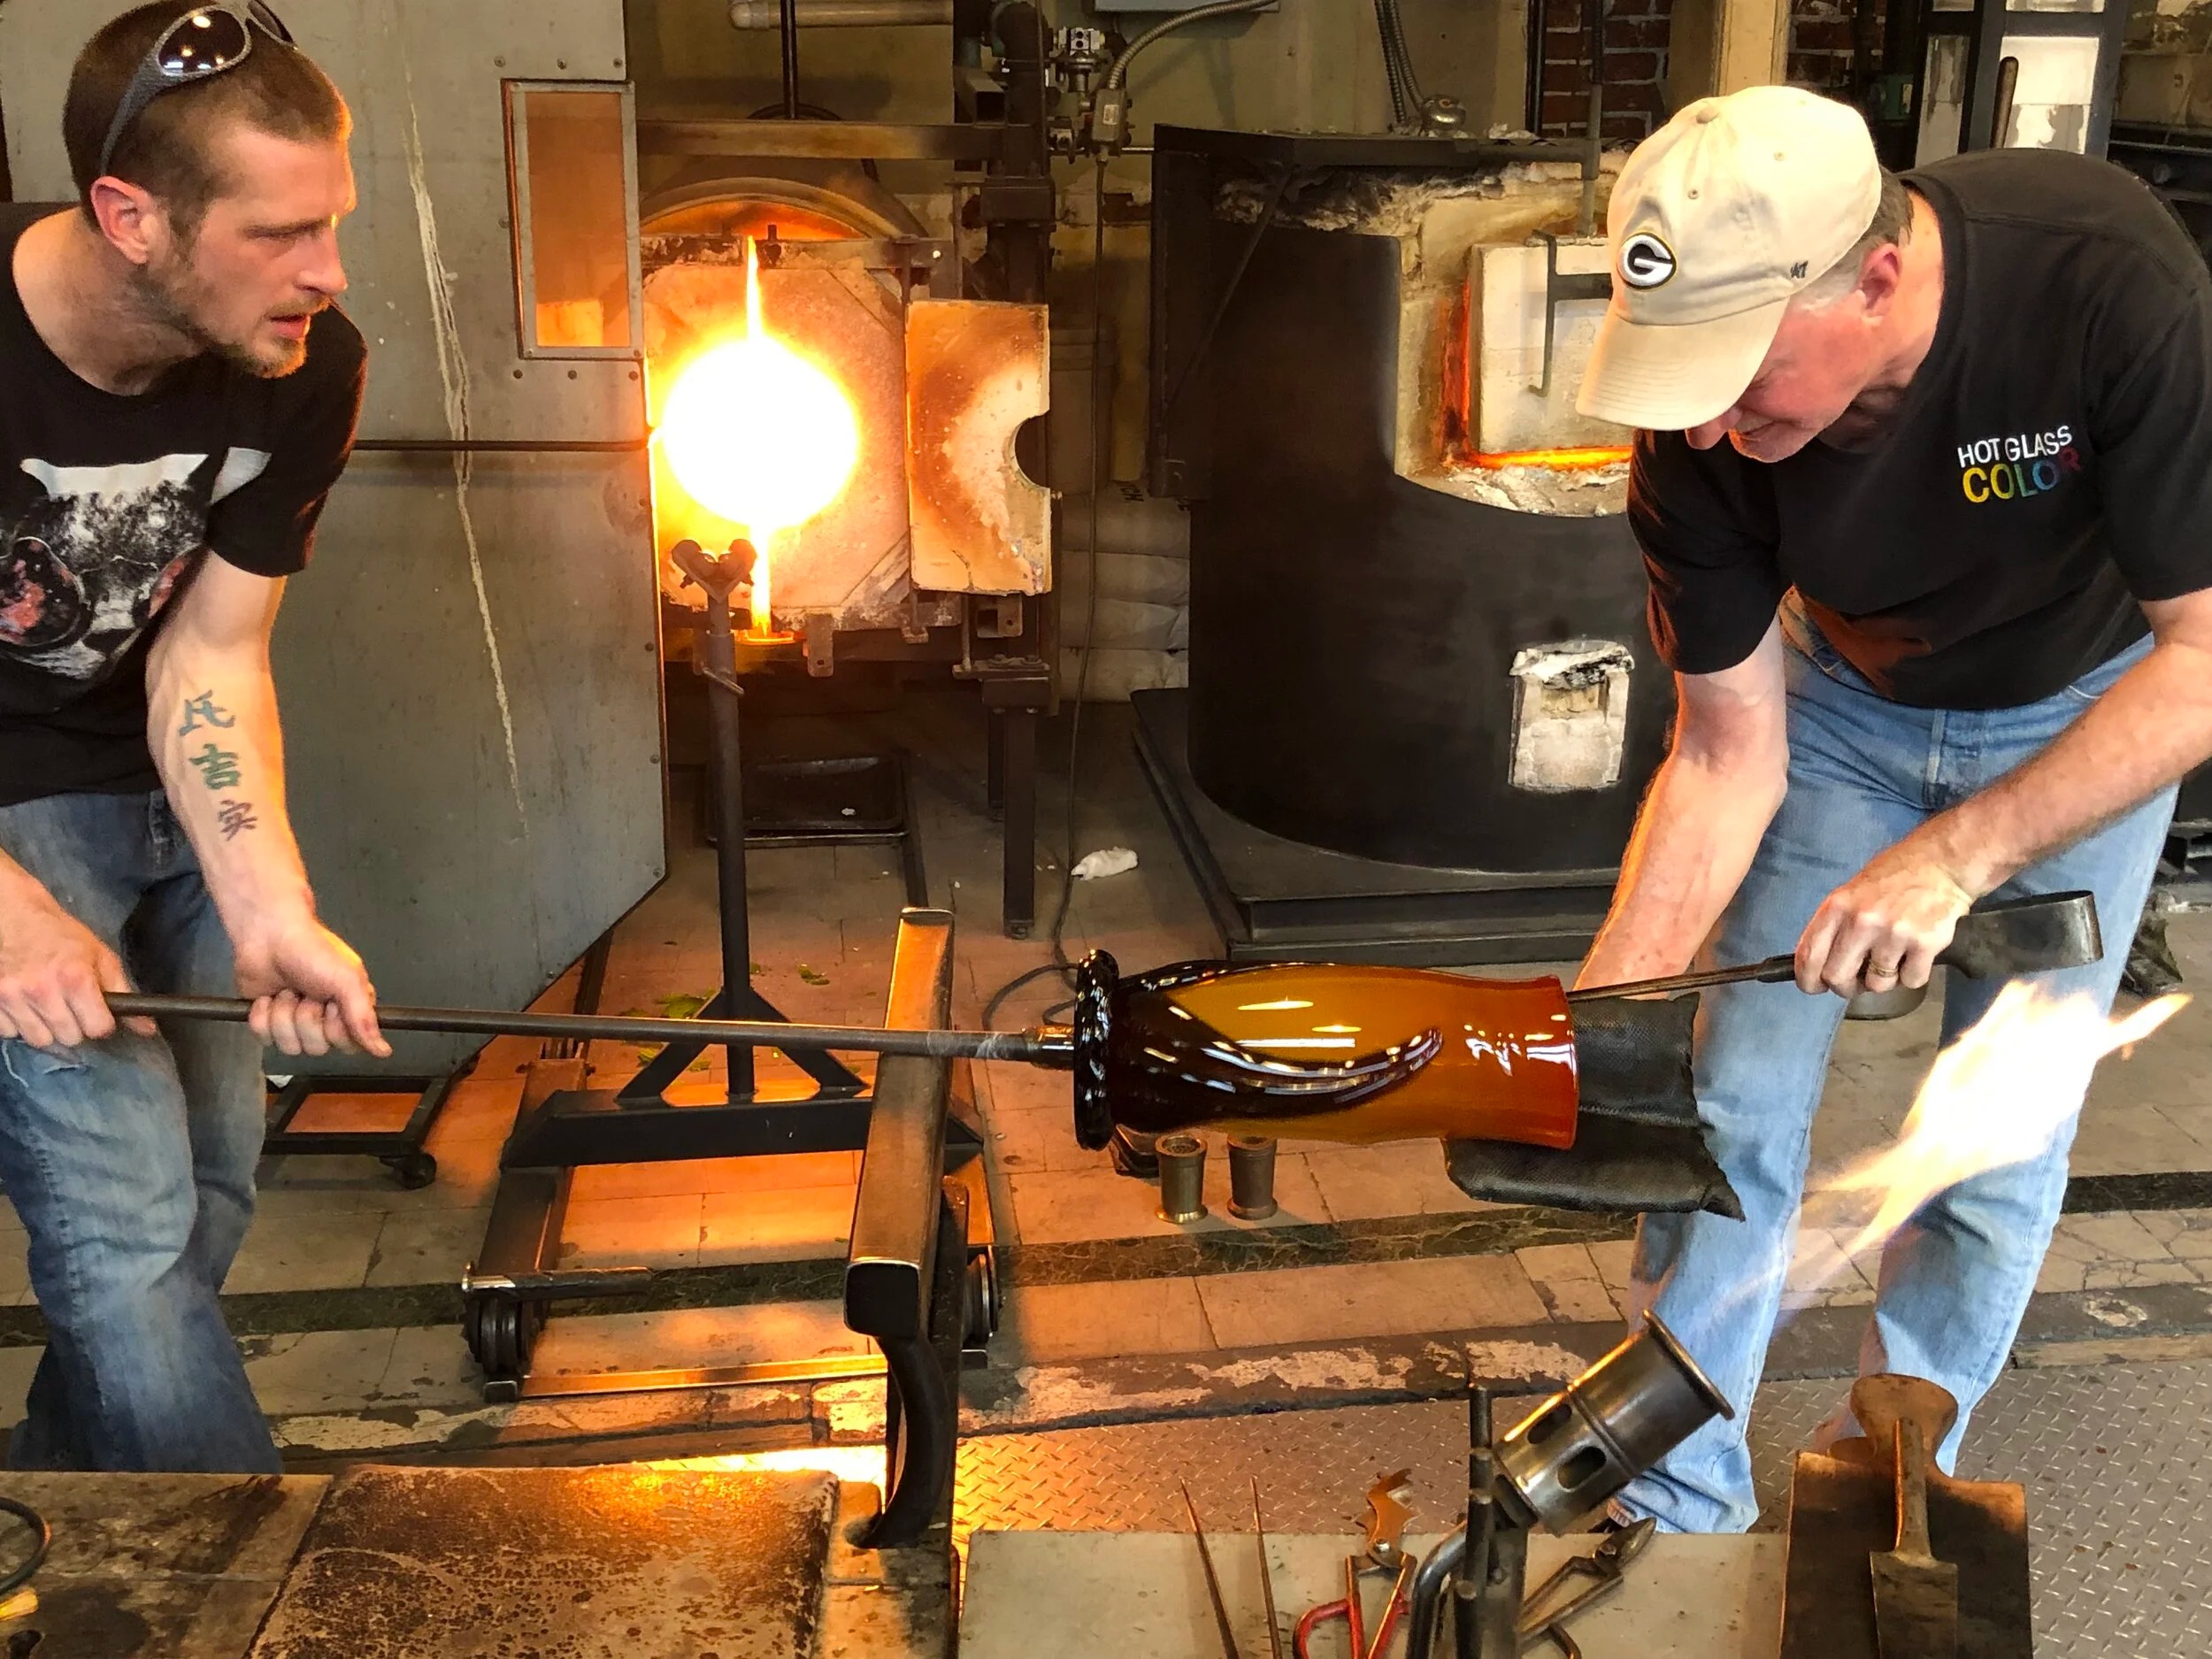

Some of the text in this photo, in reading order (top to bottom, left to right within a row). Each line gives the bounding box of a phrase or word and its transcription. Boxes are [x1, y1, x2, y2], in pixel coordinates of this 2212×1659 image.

[1617, 233, 1676, 289] G
[1957, 426, 2072, 468] HOT GLASS
[1962, 446, 2080, 503] COLOR
